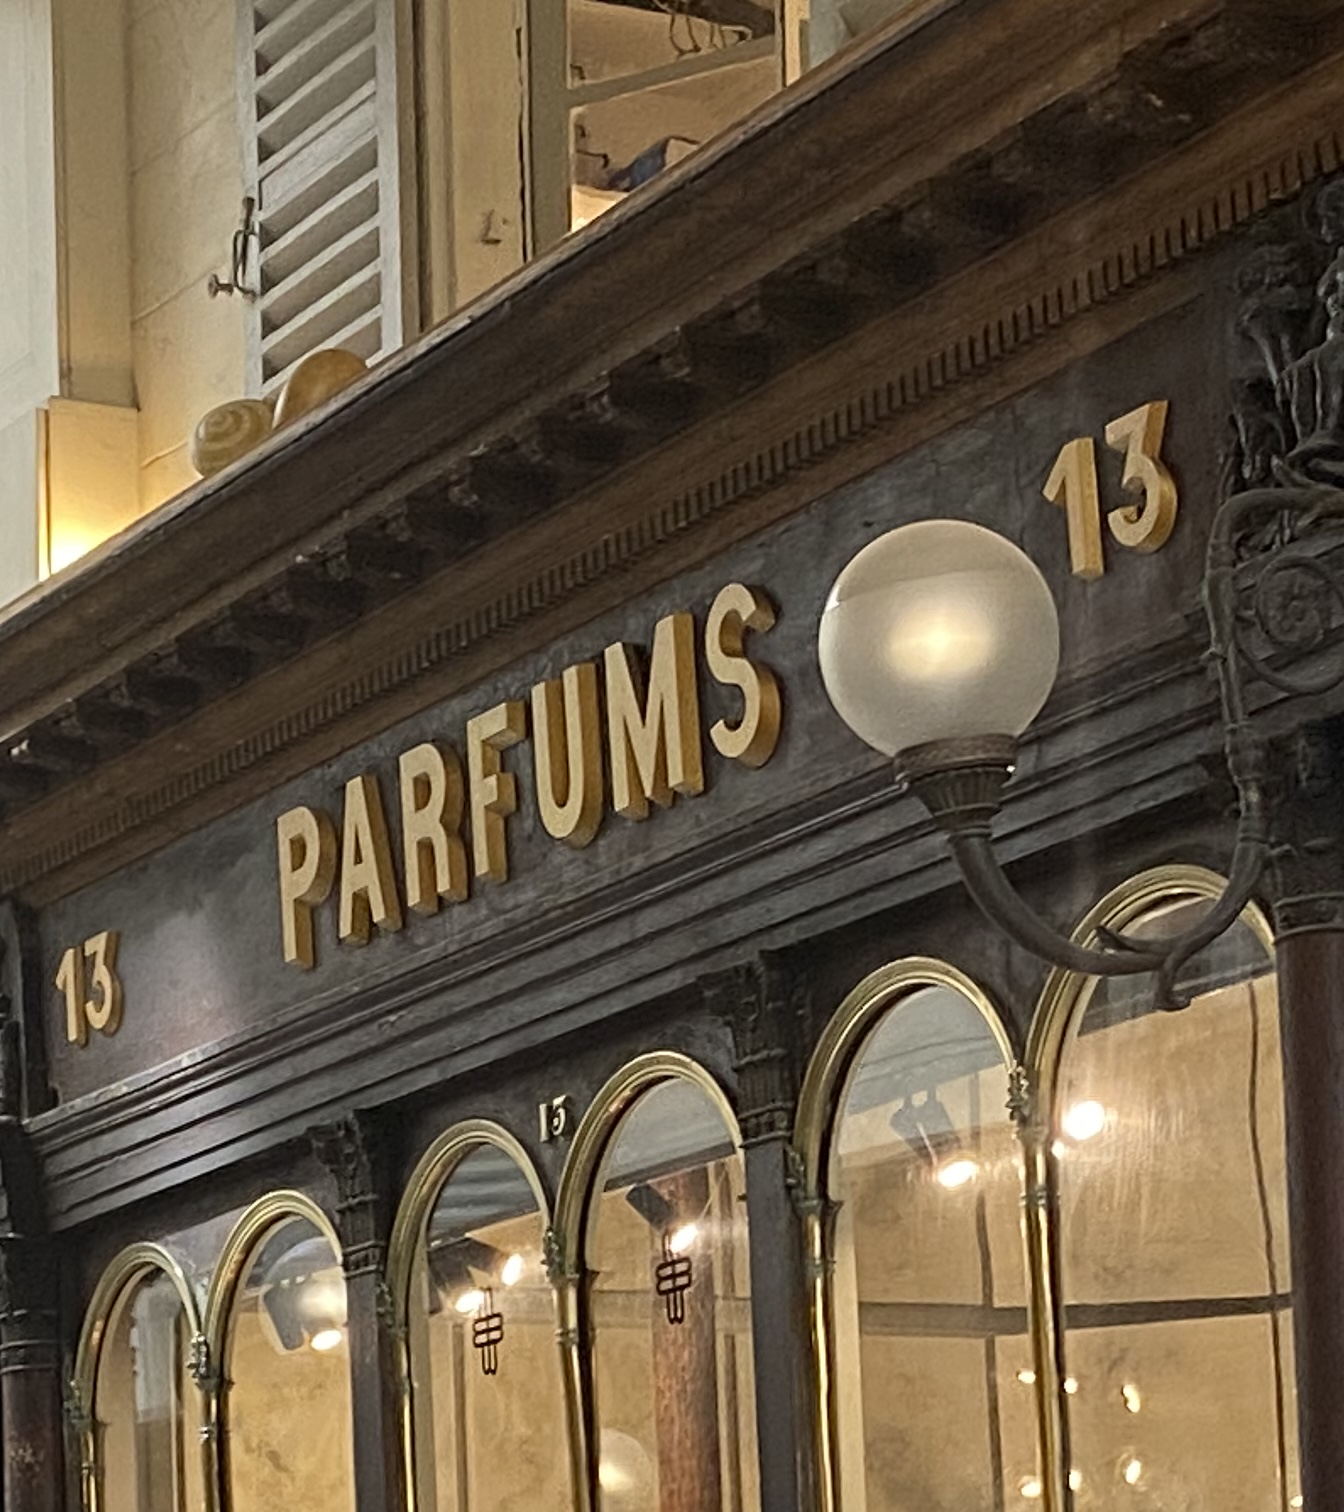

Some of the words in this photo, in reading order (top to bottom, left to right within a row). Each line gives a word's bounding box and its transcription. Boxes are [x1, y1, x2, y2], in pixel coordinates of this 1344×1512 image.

[1042, 399, 1178, 579] 13
[276, 582, 782, 970] PARFUMS
[55, 930, 122, 1046] 13
